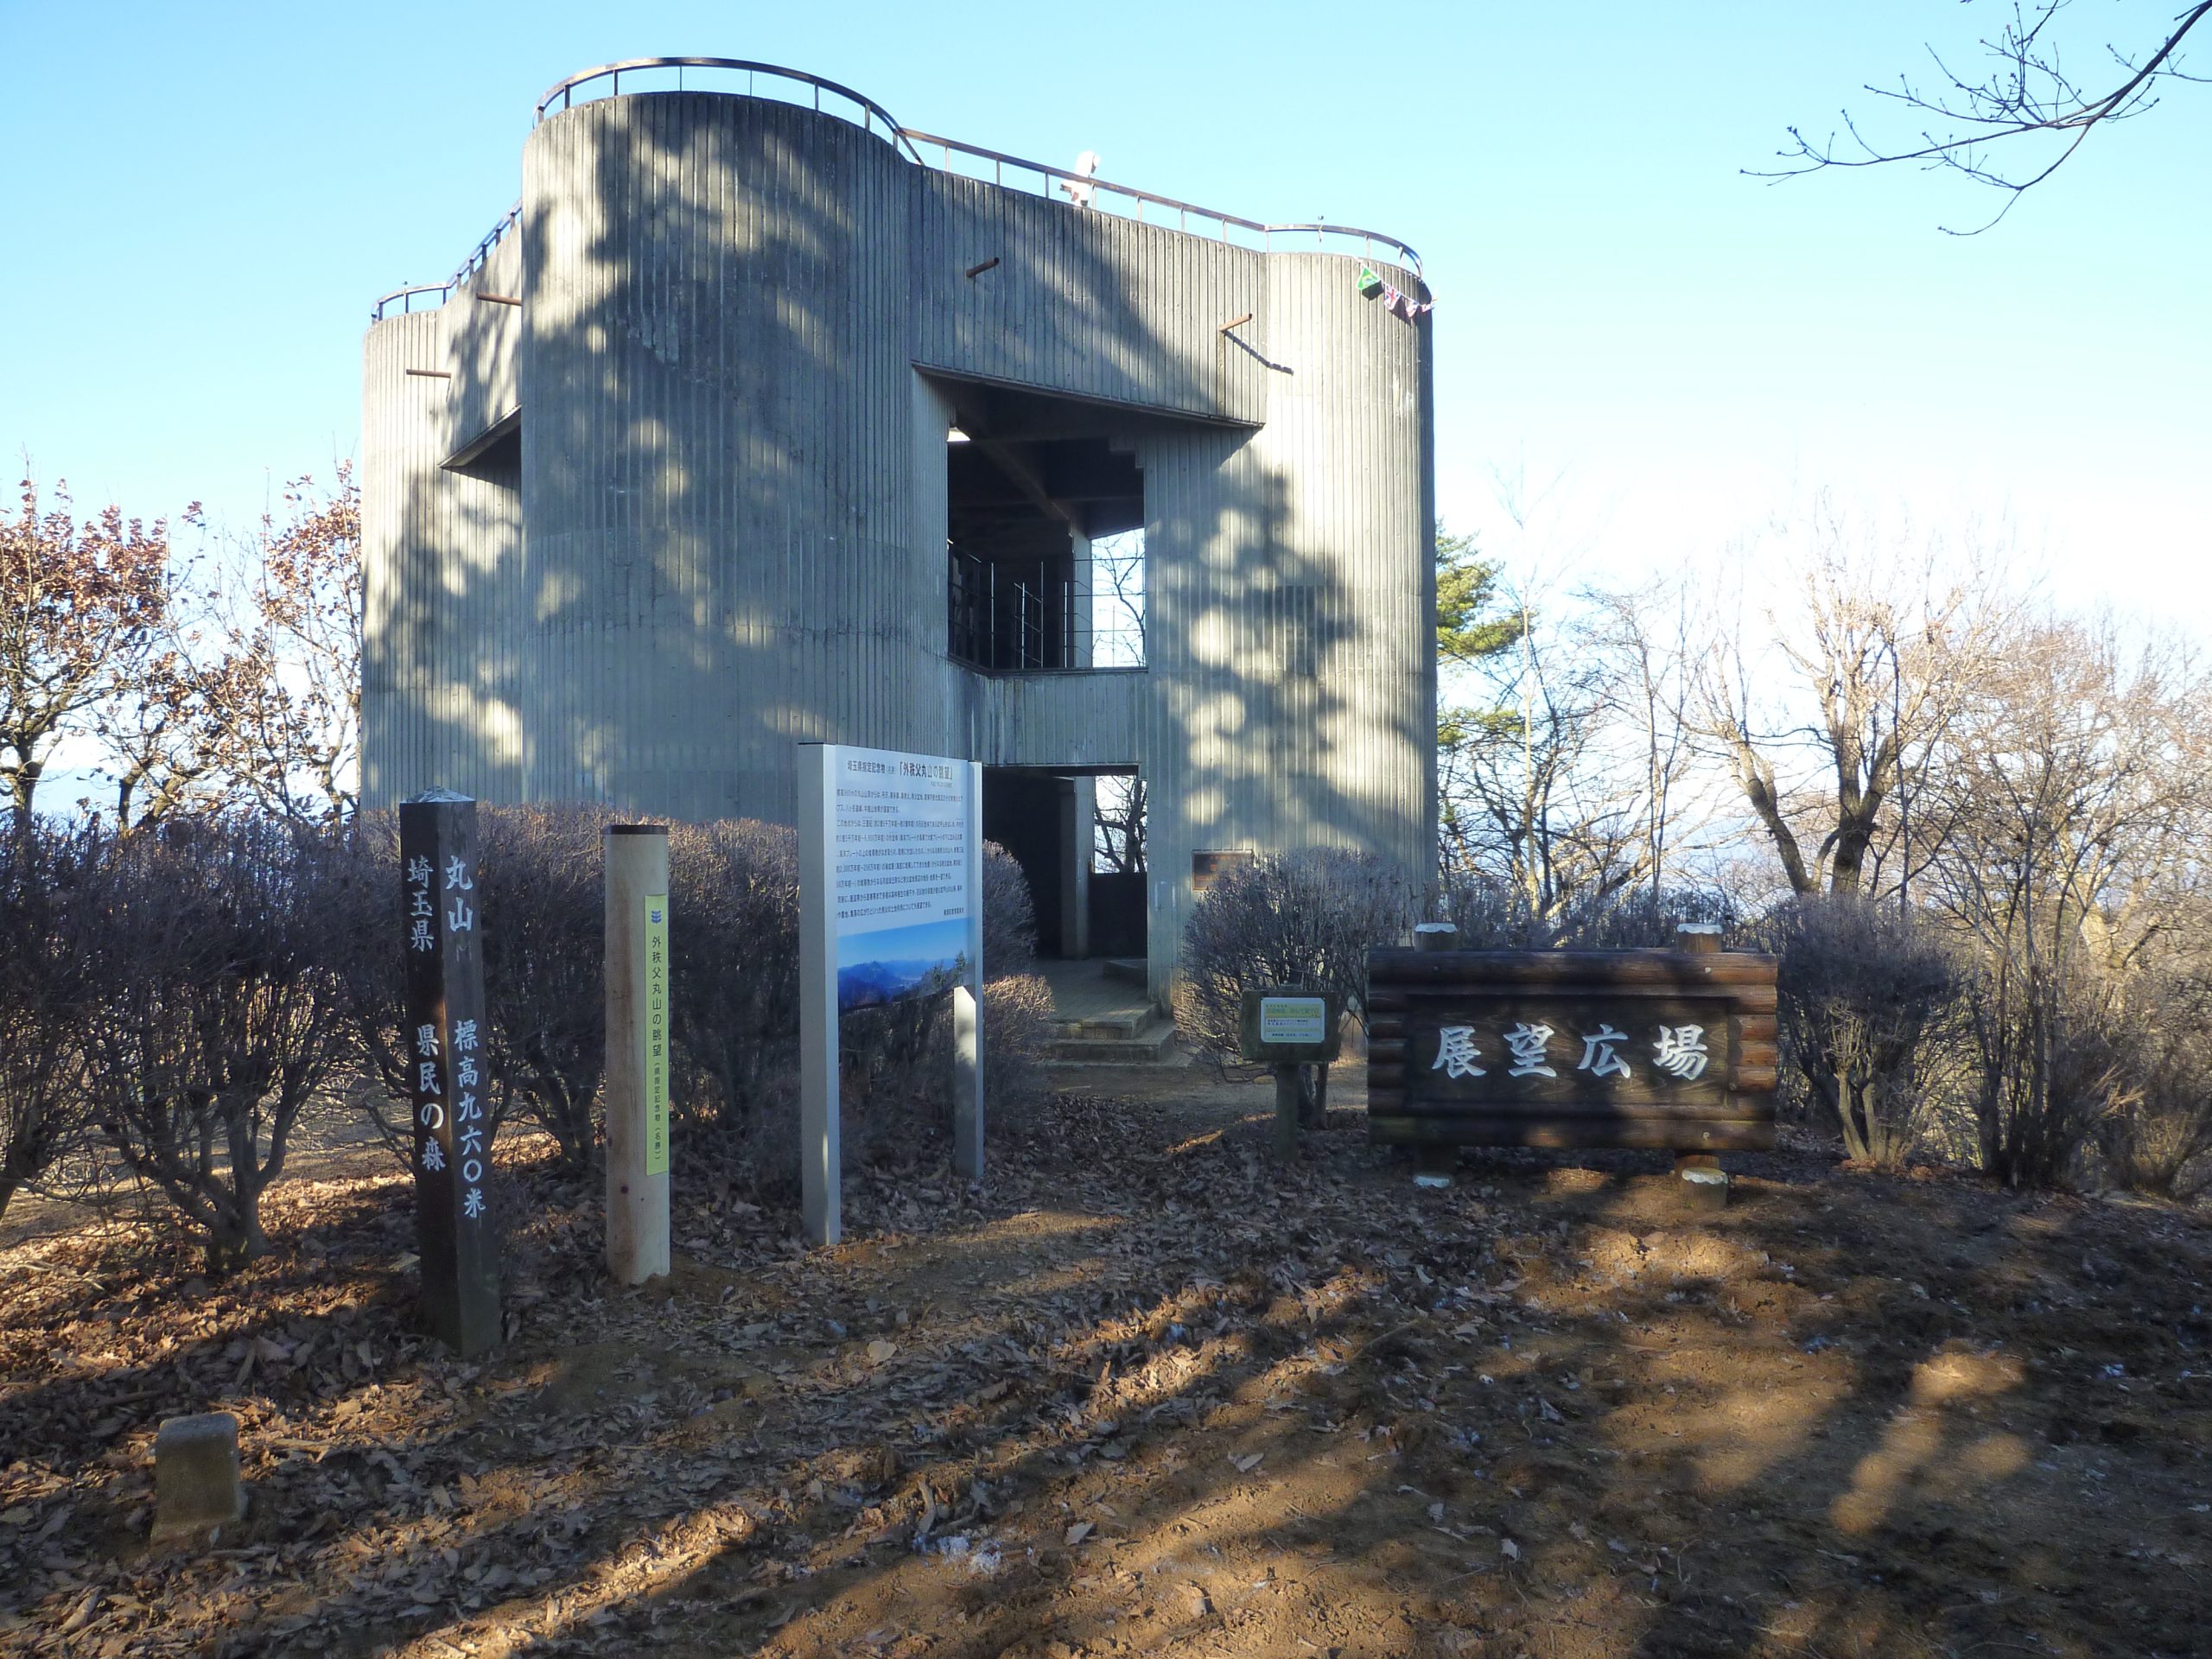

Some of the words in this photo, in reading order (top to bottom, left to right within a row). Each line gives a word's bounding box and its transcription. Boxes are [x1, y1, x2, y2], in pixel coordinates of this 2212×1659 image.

[407, 855, 435, 952] 埼玉県
[445, 855, 474, 932] 丸山
[1431, 1022, 1710, 1081] 展望広場
[416, 1024, 447, 1172] 県民の森
